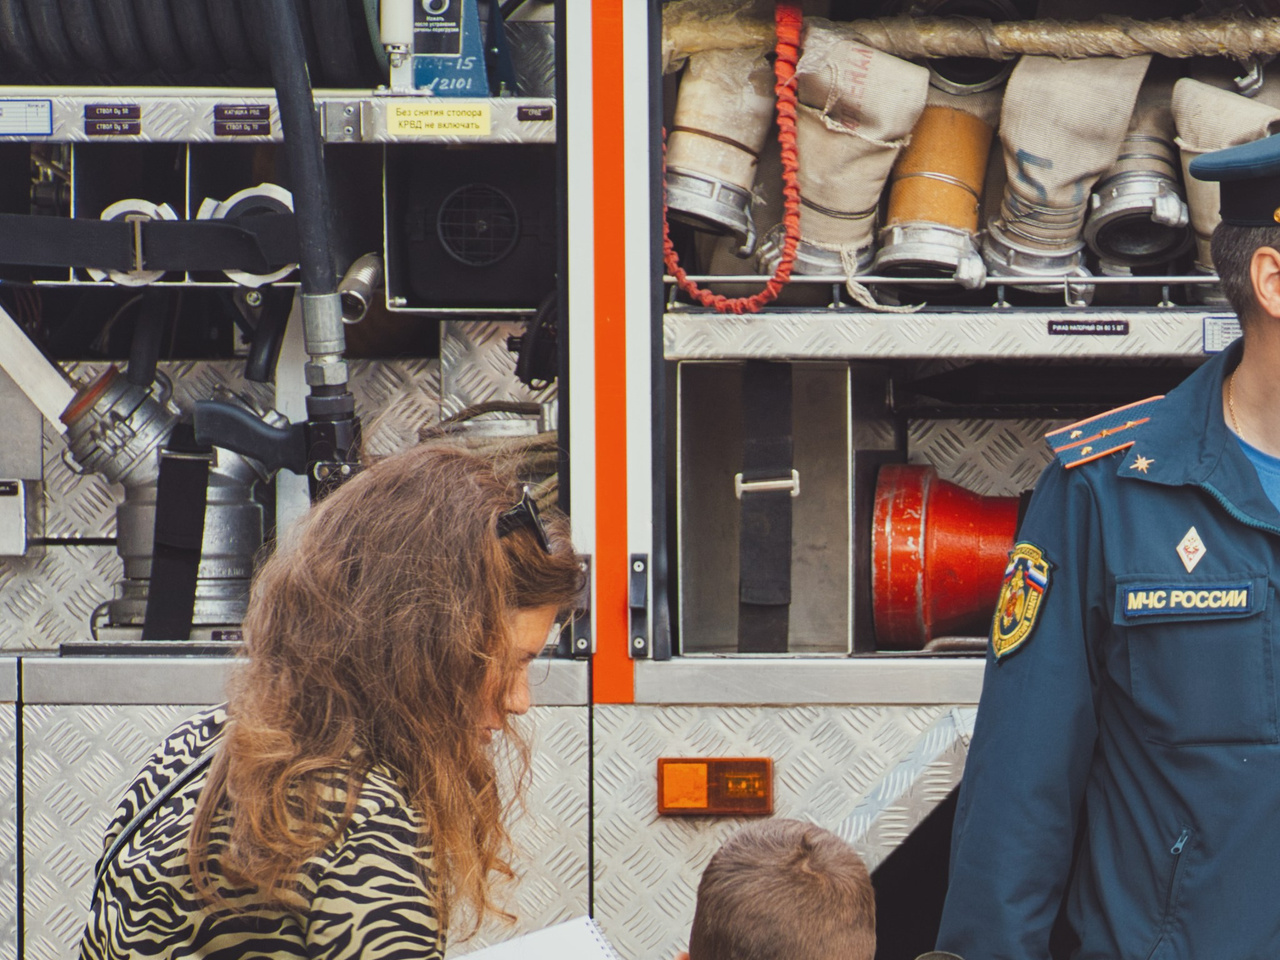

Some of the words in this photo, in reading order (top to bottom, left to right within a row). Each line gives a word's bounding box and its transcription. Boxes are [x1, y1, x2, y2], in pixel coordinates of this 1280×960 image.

[396, 107, 411, 116] Без
[446, 109, 482, 118] стопора
[398, 121, 422, 130] КРВД
[1127, 590, 1166, 609] МЧС
[1170, 590, 1247, 608] РОССИИ
